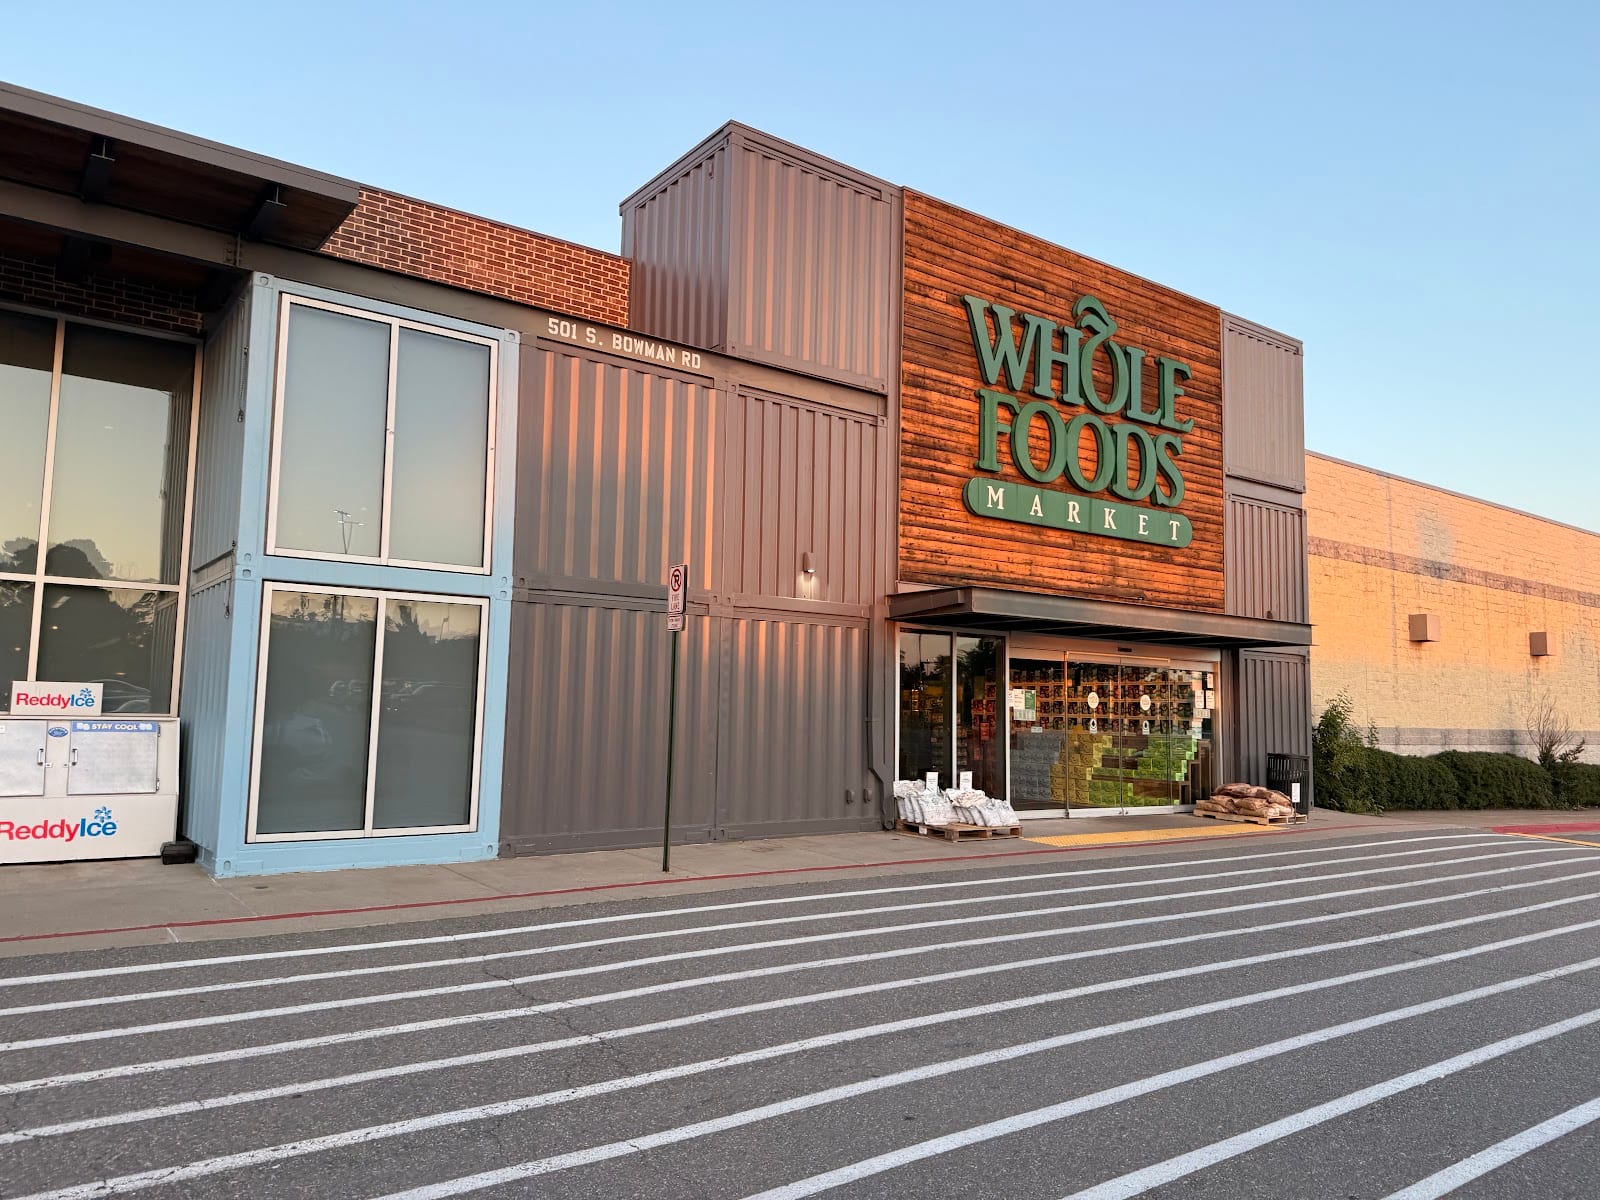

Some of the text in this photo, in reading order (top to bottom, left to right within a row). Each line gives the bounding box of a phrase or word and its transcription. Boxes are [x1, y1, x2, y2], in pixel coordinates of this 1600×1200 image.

[548, 317, 701, 369] 501 S. BOWMAN RD
[961, 295, 1194, 433] WHOLE
[975, 388, 1185, 508] FOODS
[987, 485, 1181, 541] MARKET
[114, 723, 138, 731] COOL
